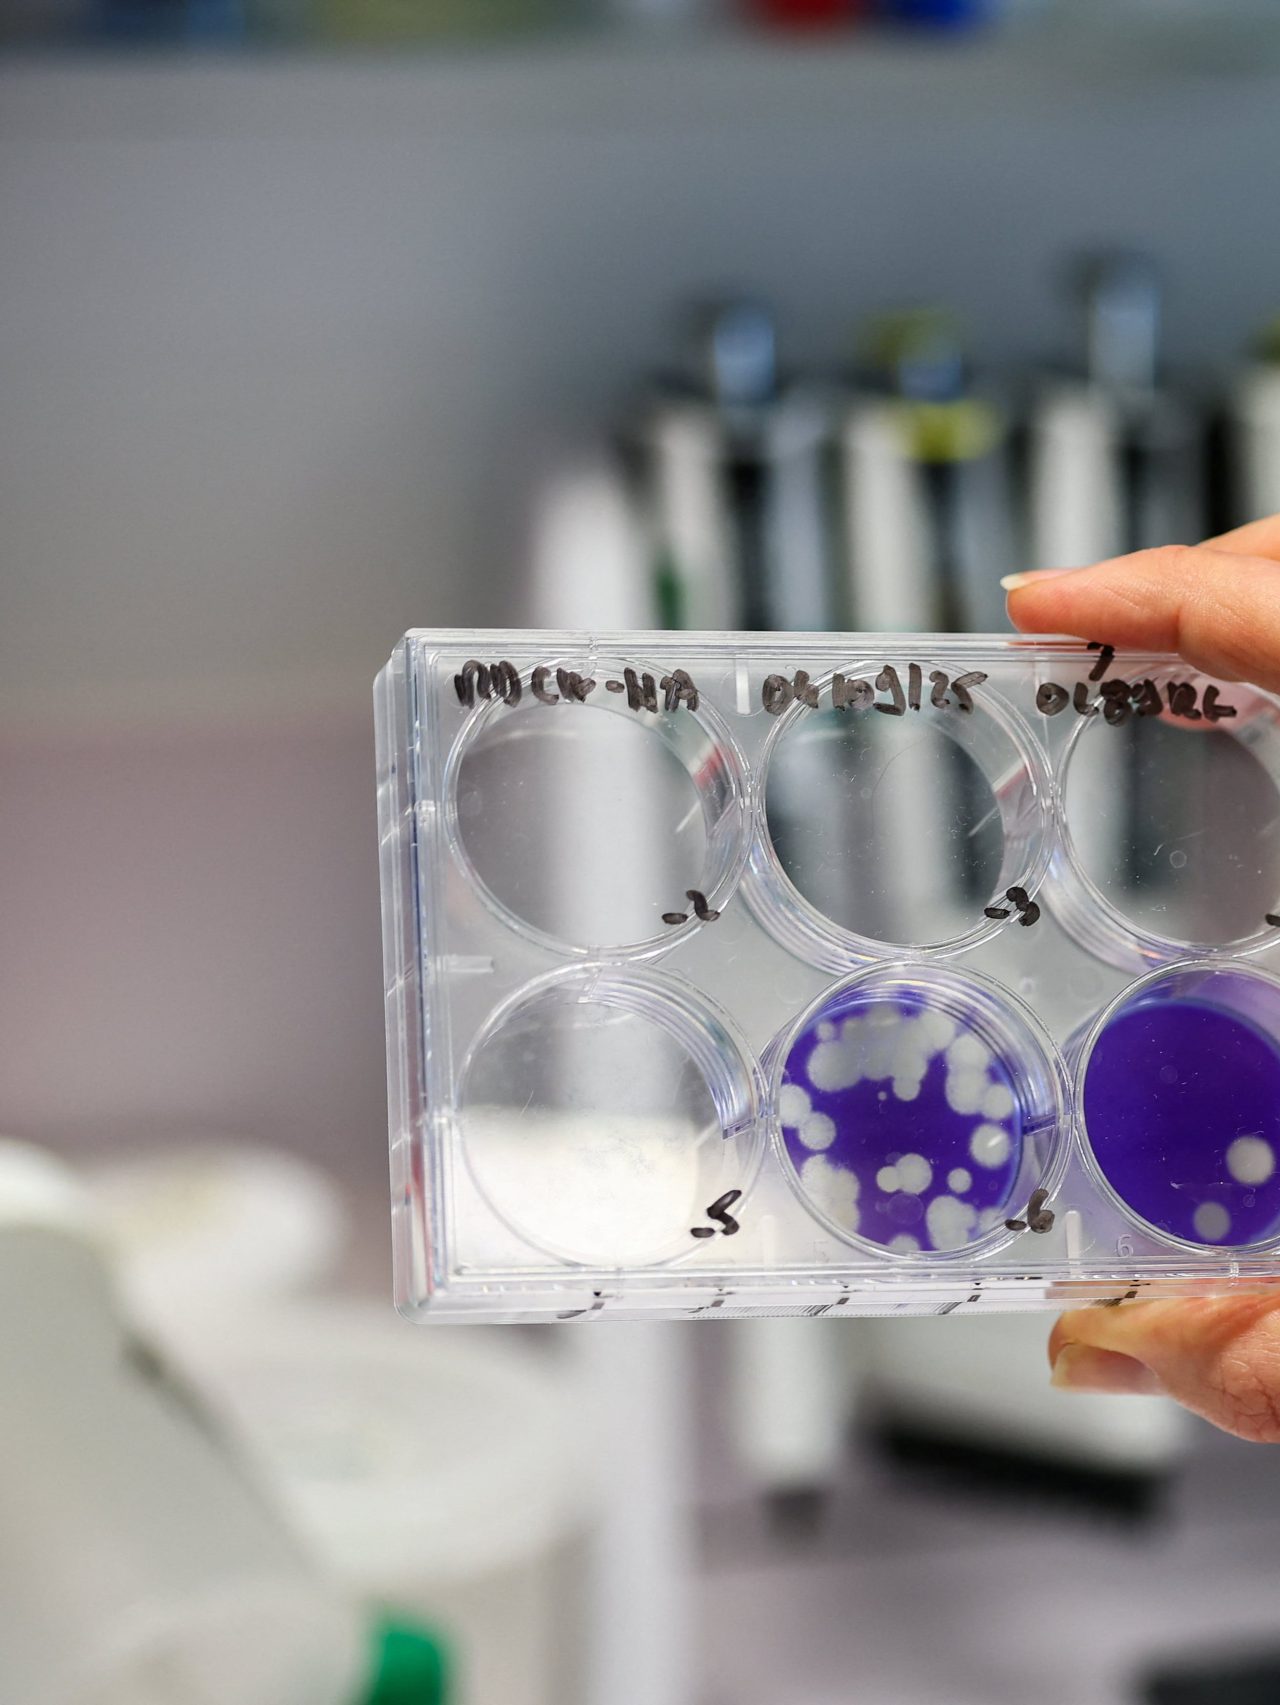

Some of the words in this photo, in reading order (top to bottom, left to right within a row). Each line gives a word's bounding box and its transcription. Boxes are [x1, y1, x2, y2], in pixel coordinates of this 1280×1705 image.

[983, 886, 1041, 927] -3
[1004, 1188, 1055, 1234] -6
[1115, 1233, 1134, 1258] 6
